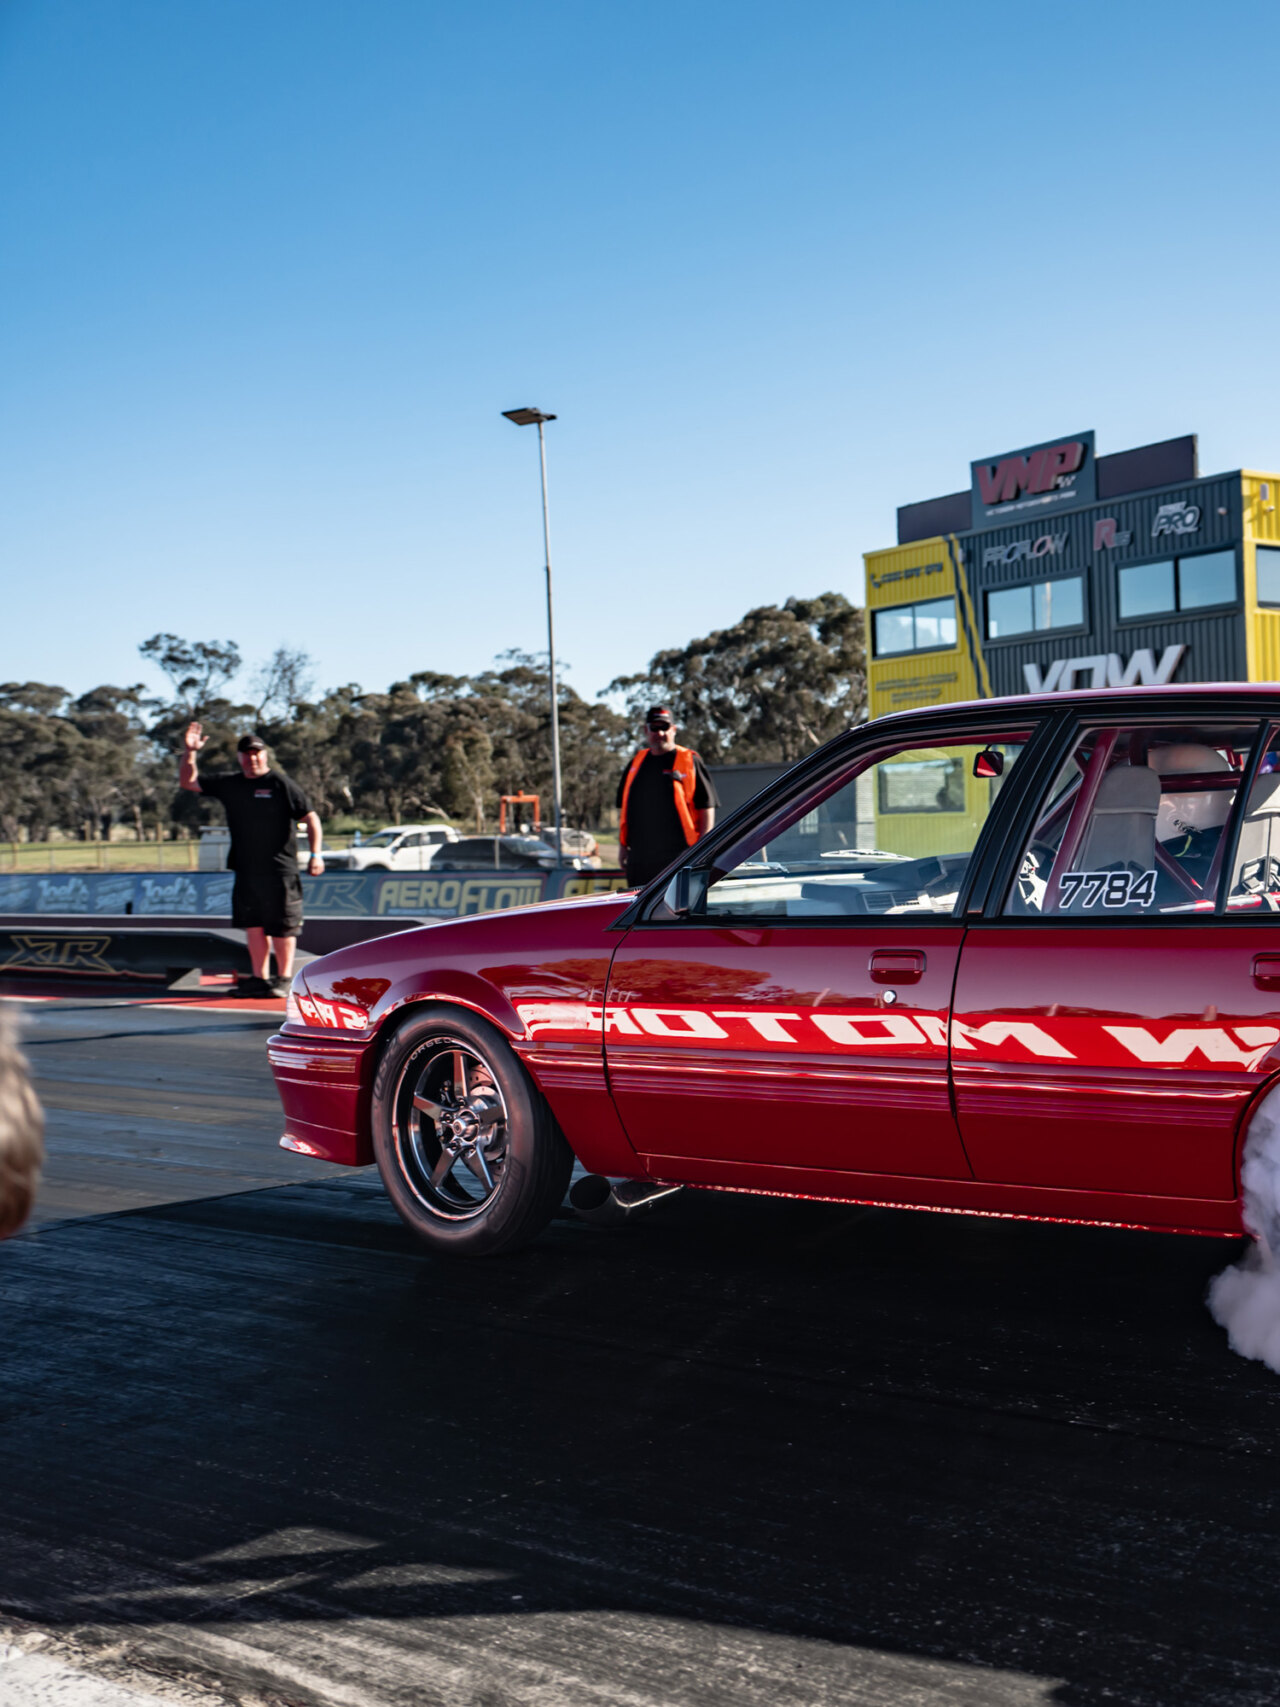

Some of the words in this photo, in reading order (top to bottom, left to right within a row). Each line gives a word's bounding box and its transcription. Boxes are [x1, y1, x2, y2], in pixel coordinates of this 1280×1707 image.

[976, 442, 1084, 505] VMP
[983, 532, 1069, 568] PROFLOW
[377, 879, 542, 915] AEROFLOW
[1059, 870, 1158, 908] 7784
